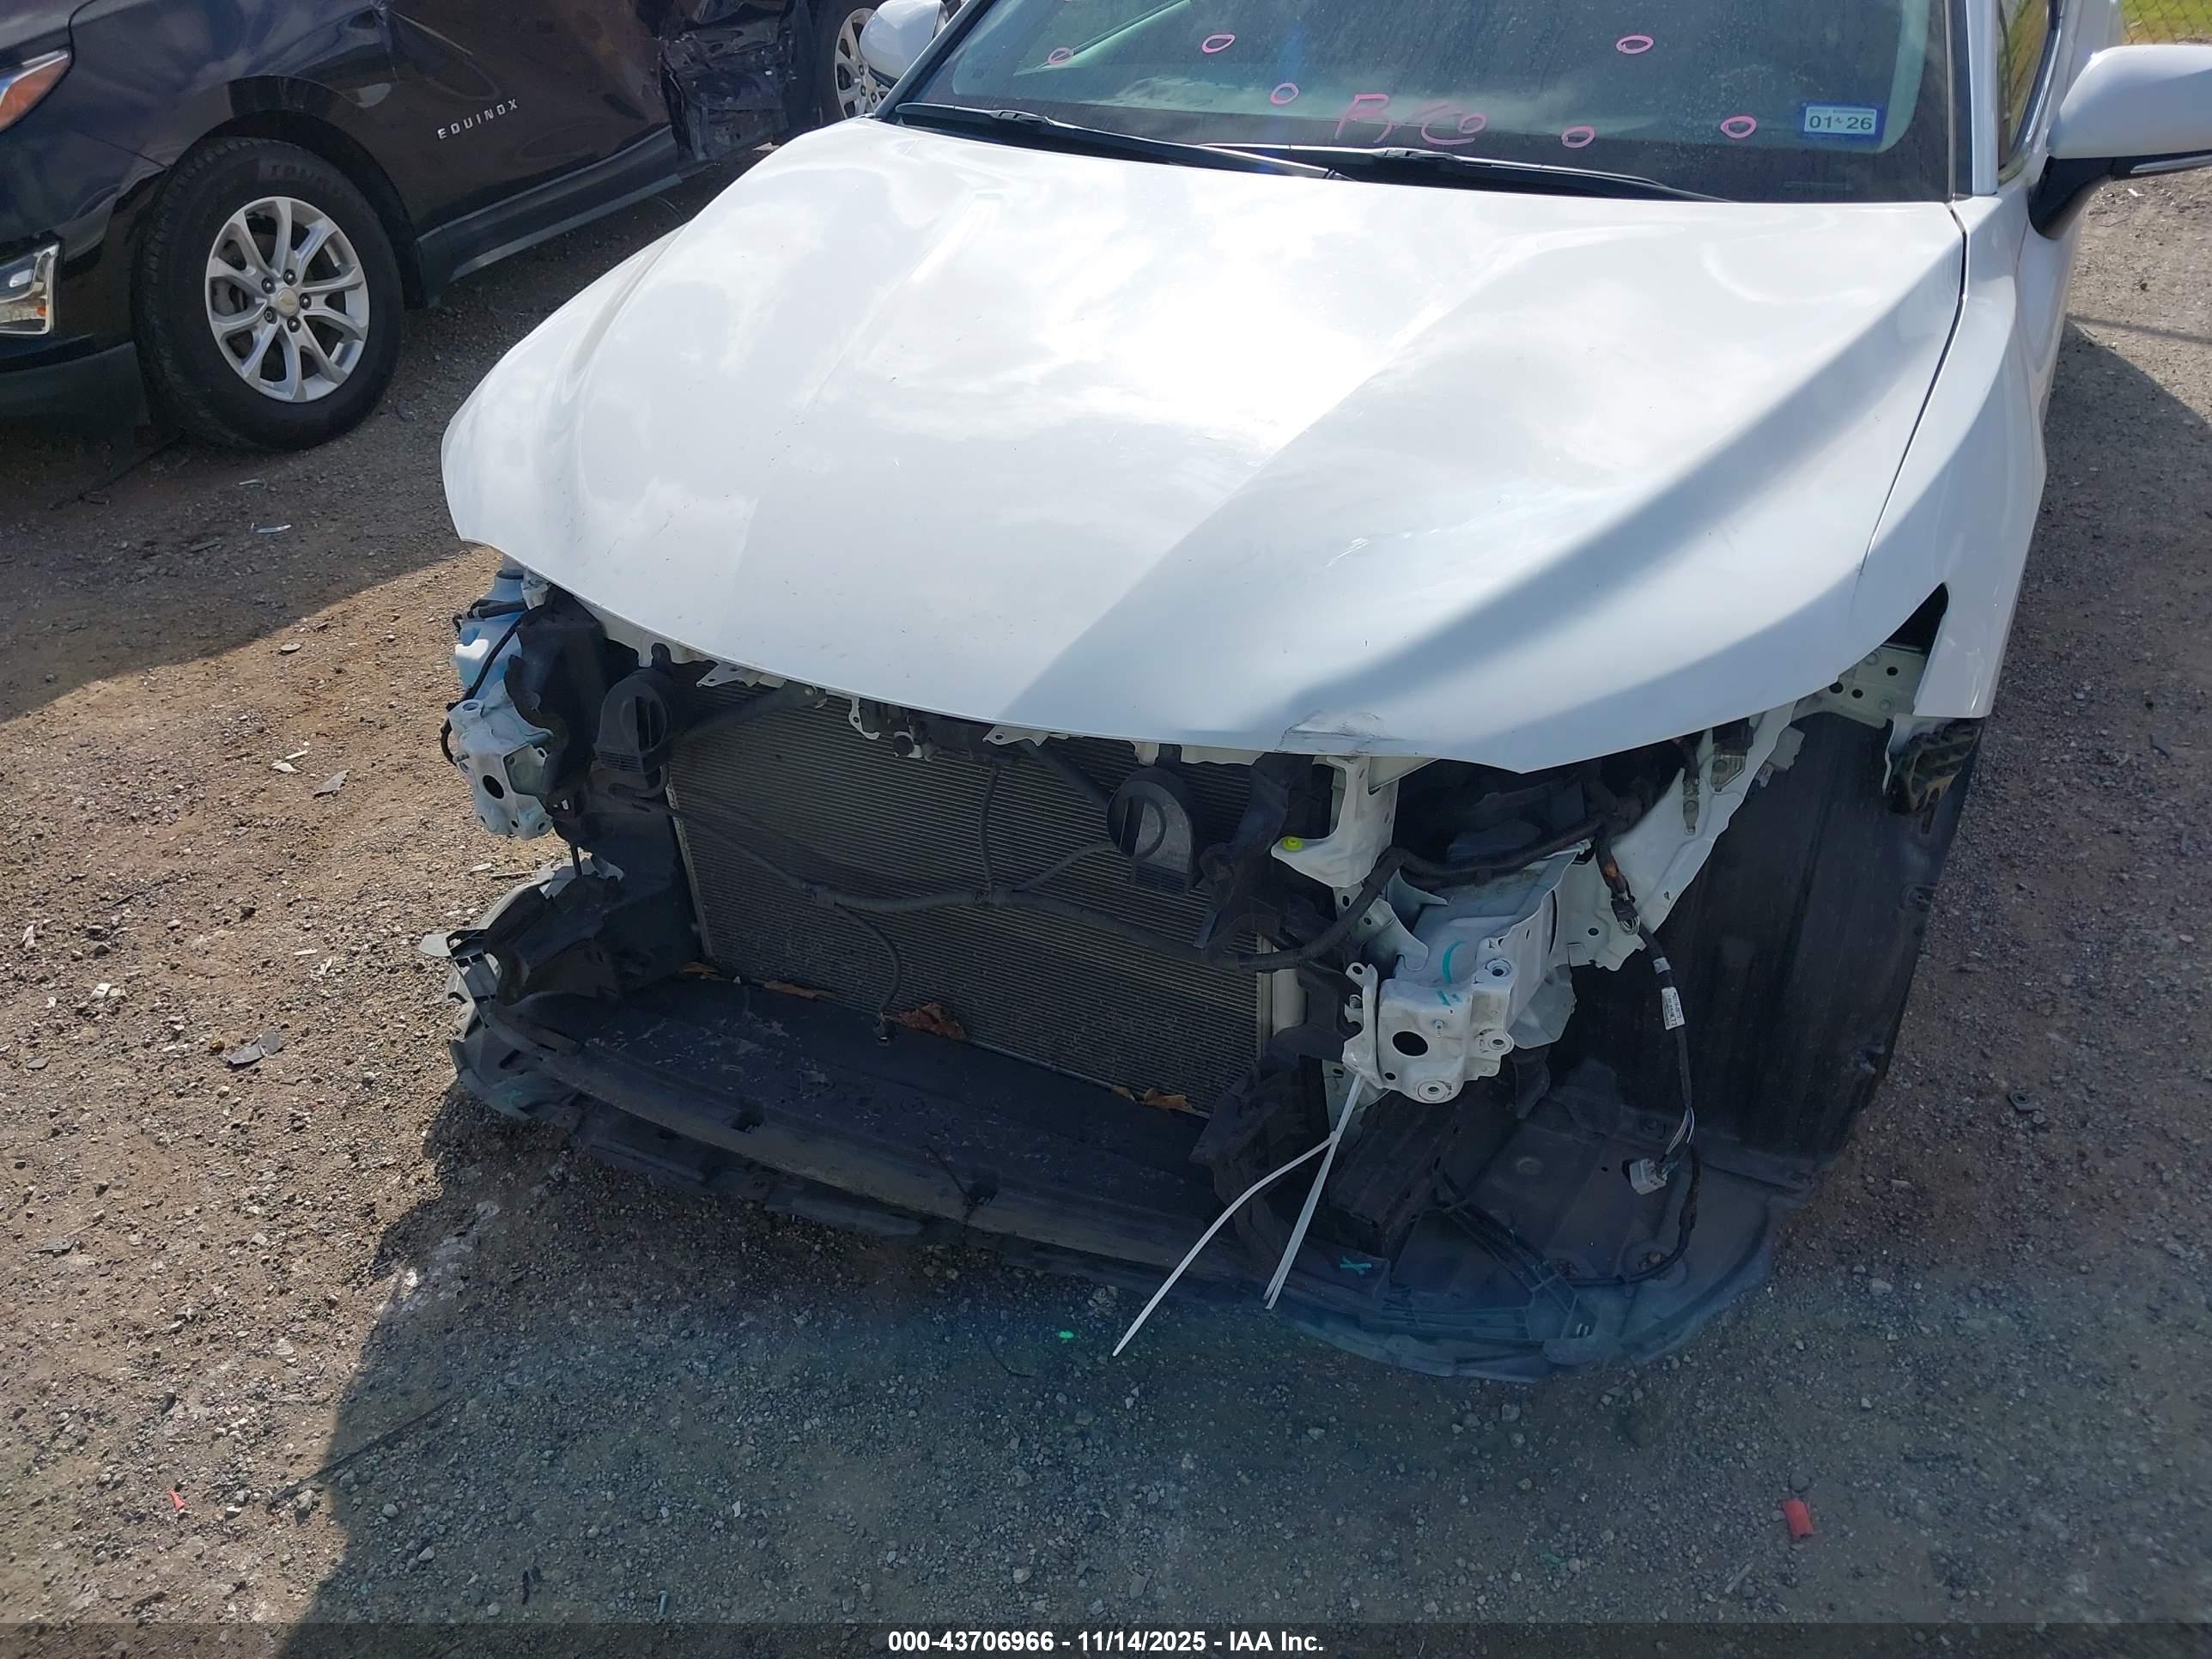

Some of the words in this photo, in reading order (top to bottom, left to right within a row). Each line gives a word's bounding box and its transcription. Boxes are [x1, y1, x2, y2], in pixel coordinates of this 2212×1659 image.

[437, 99, 518, 139] EQUINOX
[1808, 115, 1832, 129] 01
[1846, 117, 1873, 131] 26
